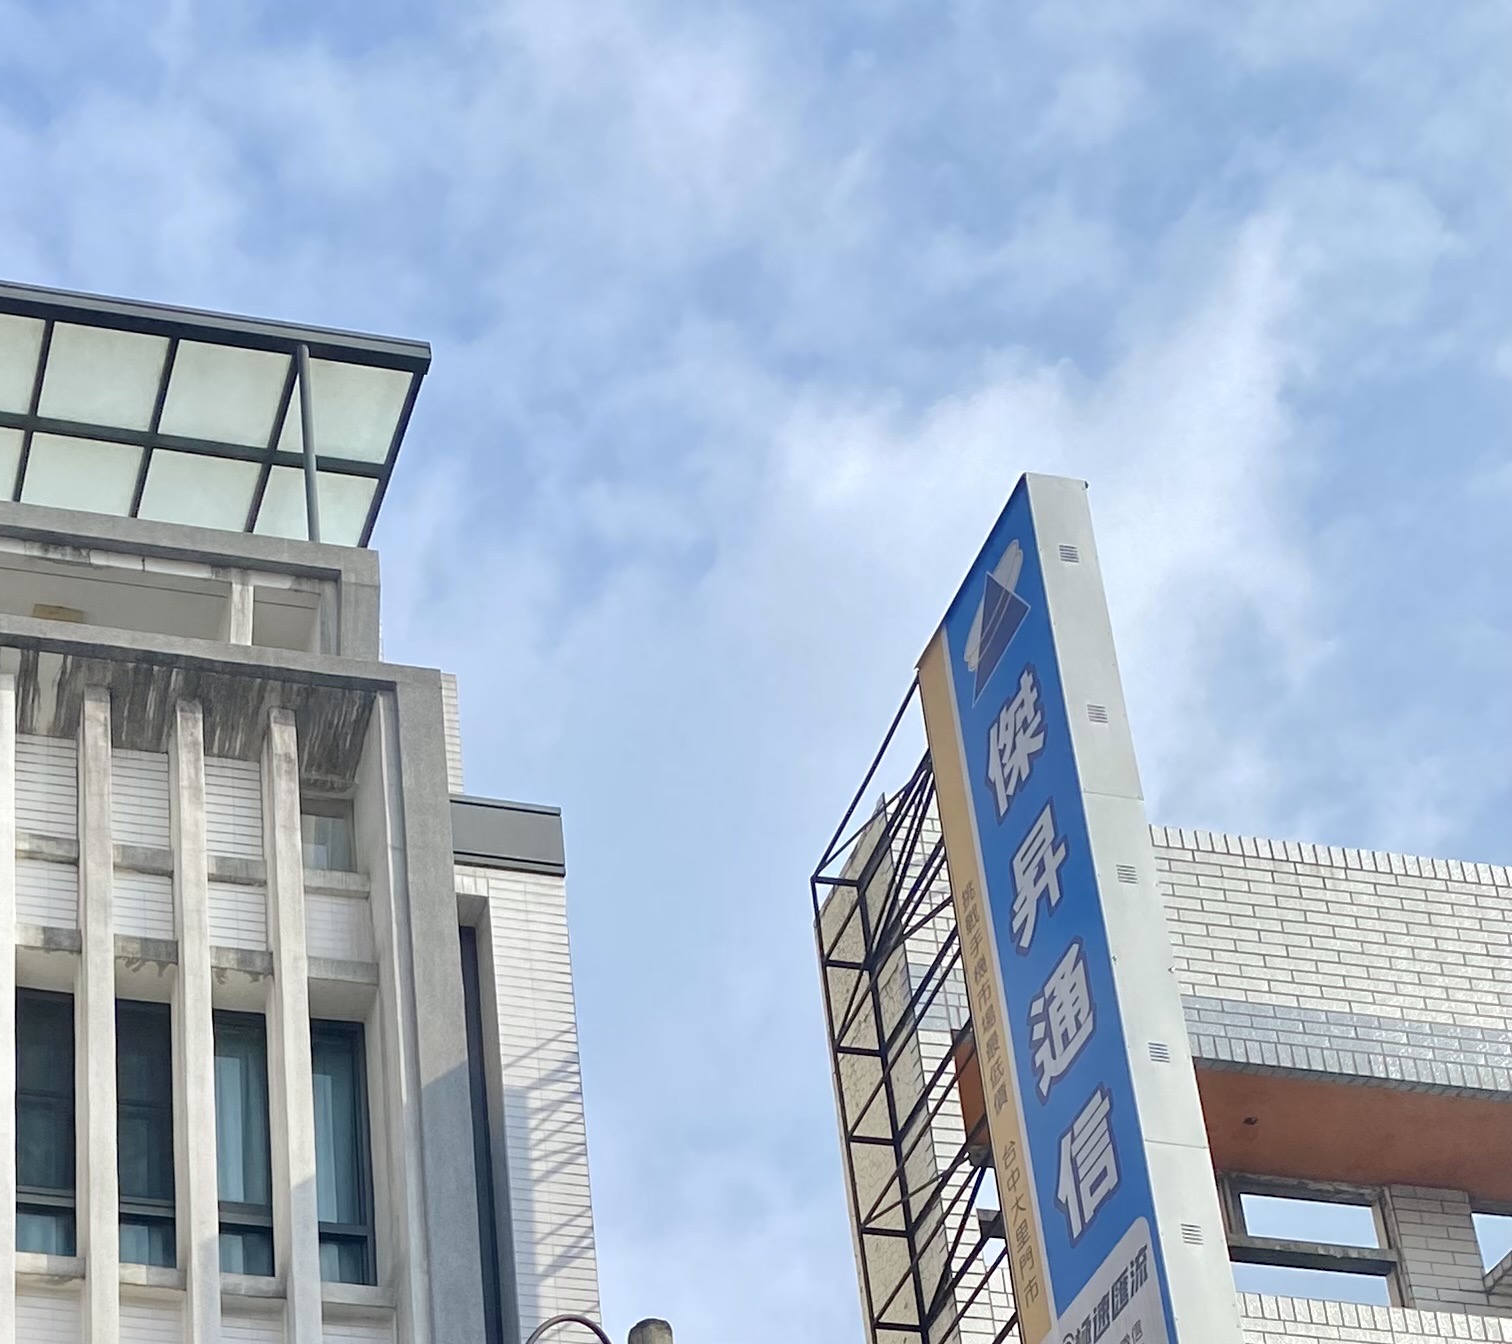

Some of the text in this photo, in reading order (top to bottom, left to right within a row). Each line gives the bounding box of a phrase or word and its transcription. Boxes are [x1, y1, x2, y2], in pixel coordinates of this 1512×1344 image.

[988, 668, 1119, 1240] 傑昇通信
[1000, 1140, 1039, 1310] 台中大里門市
